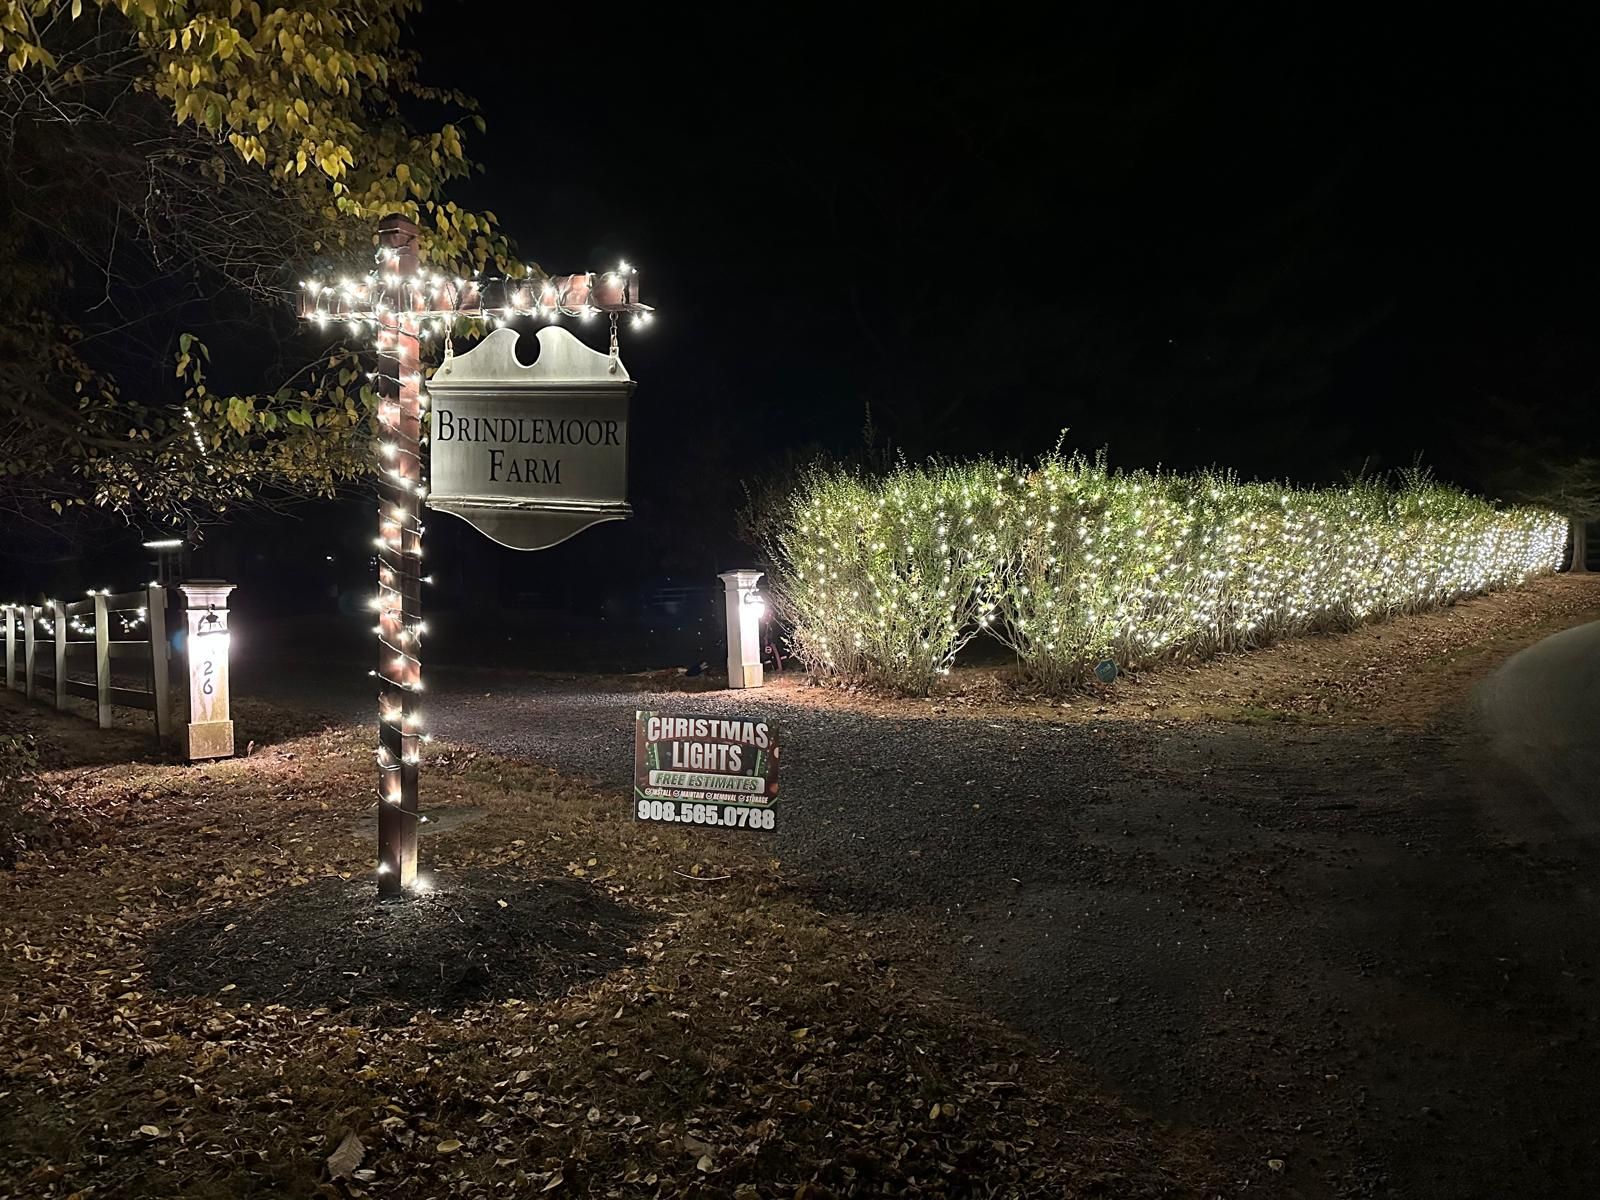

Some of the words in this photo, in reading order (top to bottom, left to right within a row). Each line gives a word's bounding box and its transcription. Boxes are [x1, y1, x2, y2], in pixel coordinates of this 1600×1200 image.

[437, 410, 620, 446] BRINDLEMOOR
[488, 449, 561, 484] FARM
[647, 716, 769, 749] CHRISTMAS
[672, 741, 742, 772] LIGHTS
[656, 773, 684, 786] FREE
[688, 776, 758, 791] ESTIMATES
